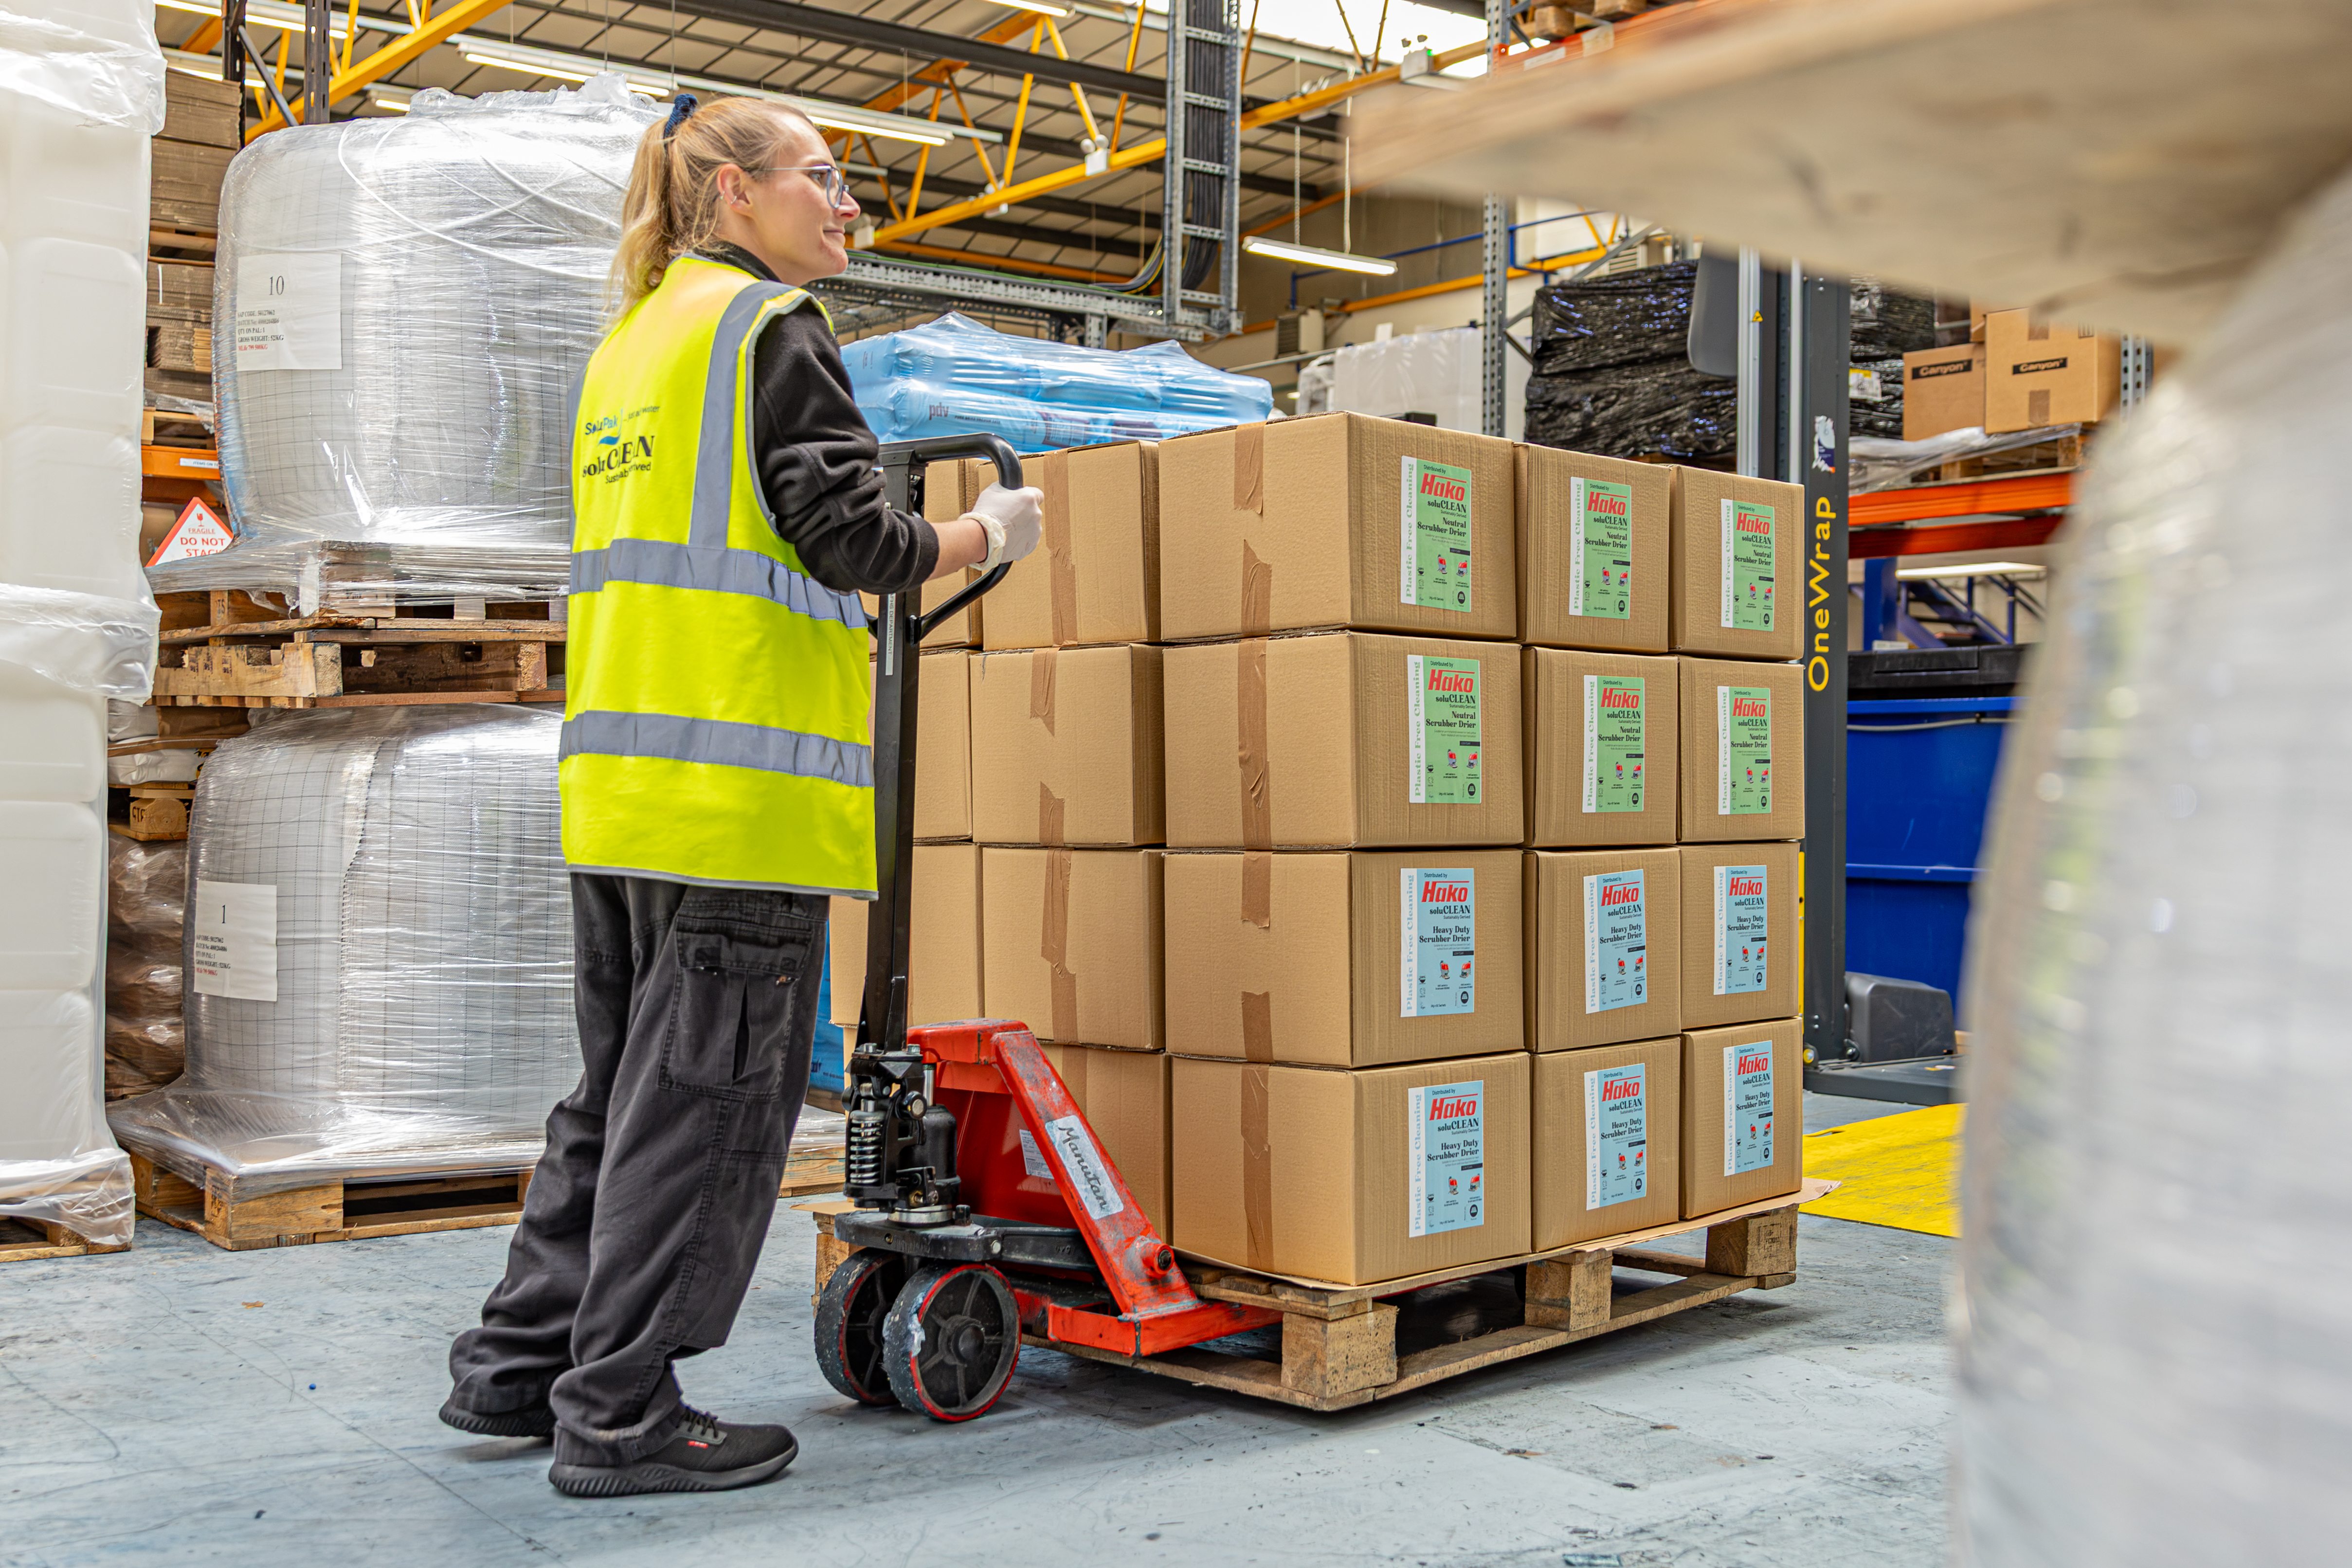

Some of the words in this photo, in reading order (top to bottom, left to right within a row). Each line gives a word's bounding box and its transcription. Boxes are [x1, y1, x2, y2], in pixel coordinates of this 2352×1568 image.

[269, 275, 284, 296] 10
[1919, 362, 1964, 377] Canyon
[2020, 360, 2060, 372] Canyon
[929, 402, 949, 420] pdv
[1420, 472, 1466, 501] Hako
[1428, 500, 1466, 513] soluCLEAN
[1587, 491, 1627, 515] Hako
[1443, 517, 1466, 528] Neutral
[1593, 516, 1627, 526] soluCLEAN
[1736, 512, 1771, 535] Hako
[1417, 521, 1447, 533] Scrubber
[1449, 527, 1466, 537] Drier
[180, 537, 197, 545] DO
[201, 538, 225, 546] NOT
[1585, 537, 1611, 547] Scrubber
[1607, 531, 1627, 541] Neutral
[1742, 535, 1771, 544] soluCLEAN
[1734, 555, 1757, 563] Scrubber
[1753, 549, 1771, 558] Neutral
[1808, 496, 1836, 692] OneWrap
[1428, 669, 1475, 693] Hako
[1435, 694, 1475, 703] soluCLEAN
[1600, 687, 1640, 708] Hako
[1732, 698, 1767, 717] Hako
[1451, 711, 1475, 719] Neutral
[1607, 710, 1640, 719] soluCLEAN
[1426, 719, 1457, 727] Scrubber
[1421, 881, 1469, 902] Hako
[1729, 876, 1763, 896] Hako
[1601, 881, 1640, 906] Hako
[1735, 897, 1764, 906] soluCLEAN
[222, 904, 226, 923] 1
[1429, 905, 1470, 914] soluCLEAN
[1608, 904, 1641, 916] soluCLEAN
[1433, 926, 1452, 935] Heavy
[1455, 925, 1470, 935] Duty
[1419, 935, 1450, 943] Scrubber
[1600, 934, 1626, 944] Scrubber
[1628, 931, 1642, 939] Drier
[1737, 1052, 1769, 1075] Hako
[1743, 1073, 1770, 1085] soluCLEAN
[1602, 1075, 1641, 1101] Hako
[1429, 1093, 1478, 1120] Hako
[1609, 1098, 1642, 1111] soluCLEAN
[1736, 1101, 1757, 1111] Scrubber
[1437, 1117, 1478, 1131] soluCLEAN
[1601, 1129, 1627, 1139] Scrubber
[1441, 1142, 1461, 1151] Heavy
[1463, 1139, 1478, 1148] Duty
[1427, 1151, 1459, 1161] Scrubber
[1058, 1127, 1107, 1210] Manutan
